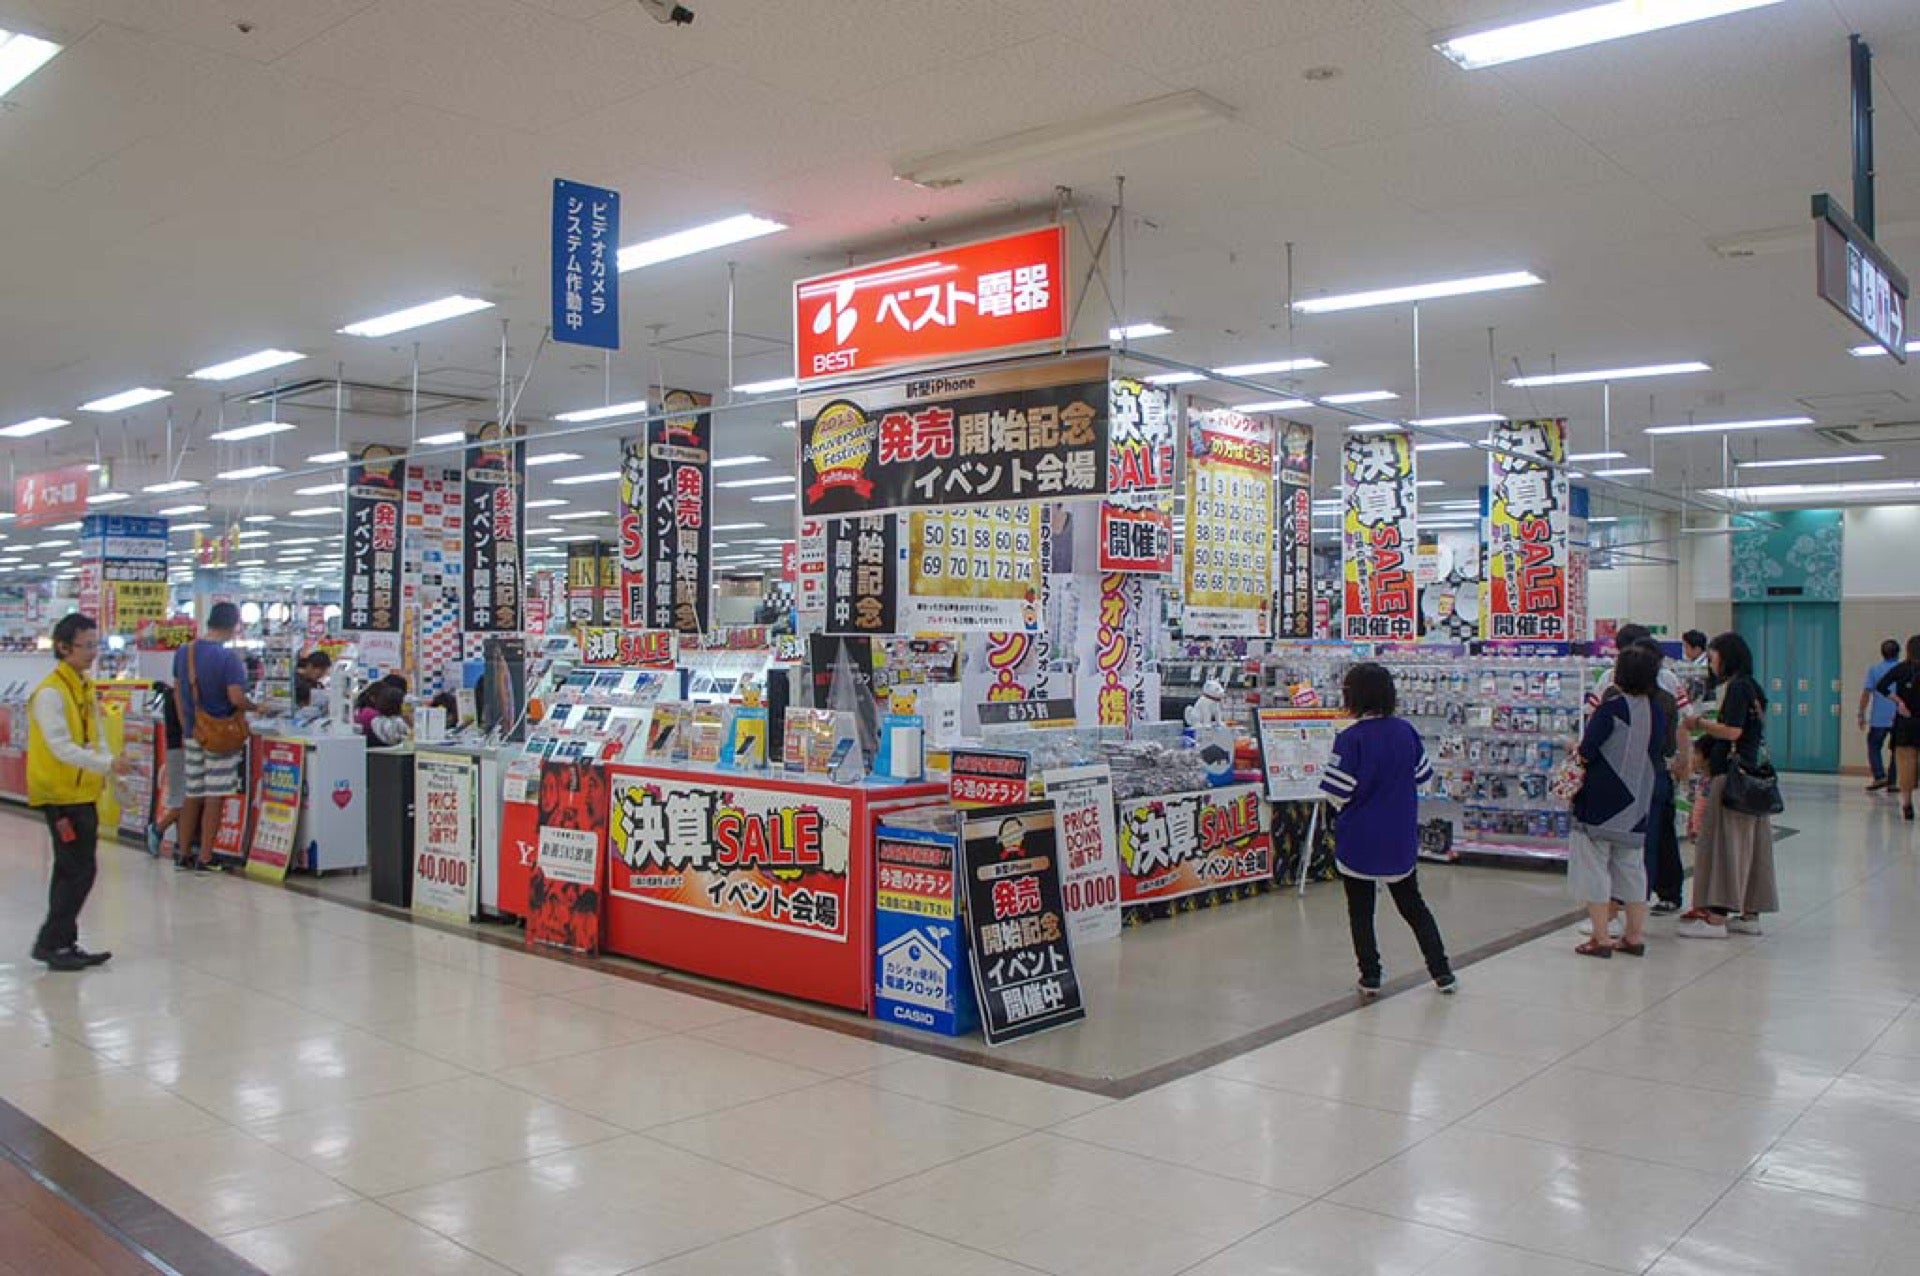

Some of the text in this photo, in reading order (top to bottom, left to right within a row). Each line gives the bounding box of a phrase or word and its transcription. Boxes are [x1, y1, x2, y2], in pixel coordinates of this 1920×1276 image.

[565, 197, 583, 330] システム作動中
[591, 201, 608, 314] ビデオカメラ
[876, 263, 1049, 332] ベスト電器
[813, 348, 859, 373] BEST
[915, 450, 1097, 498] イベント会場
[1354, 437, 1403, 527] 決算
[1496, 423, 1556, 519] 決算
[655, 472, 674, 630] イベント開催中
[925, 525, 1030, 552] 50 51 58 60 62
[1108, 519, 1171, 564] 開催中
[923, 556, 1030, 579] 69 70 71 72 74
[1372, 525, 1410, 615] SALE
[1519, 518, 1560, 613] SALE
[1347, 614, 1412, 638] 開催中
[1494, 613, 1561, 637] 開催中
[427, 791, 458, 811] PRICE
[953, 779, 1023, 803] 今週のチラシ
[427, 811, 458, 827] DOWN
[1063, 806, 1099, 833] PRICE
[1065, 827, 1102, 852] DOWN
[417, 854, 467, 887] 40,000
[880, 868, 951, 895] 今週のチラシ
[1197, 848, 1268, 880] イベント会場
[708, 879, 839, 930] イベント会場
[993, 876, 1041, 919] 発売
[981, 912, 1062, 955] 開始記念
[988, 946, 1065, 985] イベント
[893, 1005, 935, 1026] CASIO
[1001, 978, 1066, 1023] 開催中
